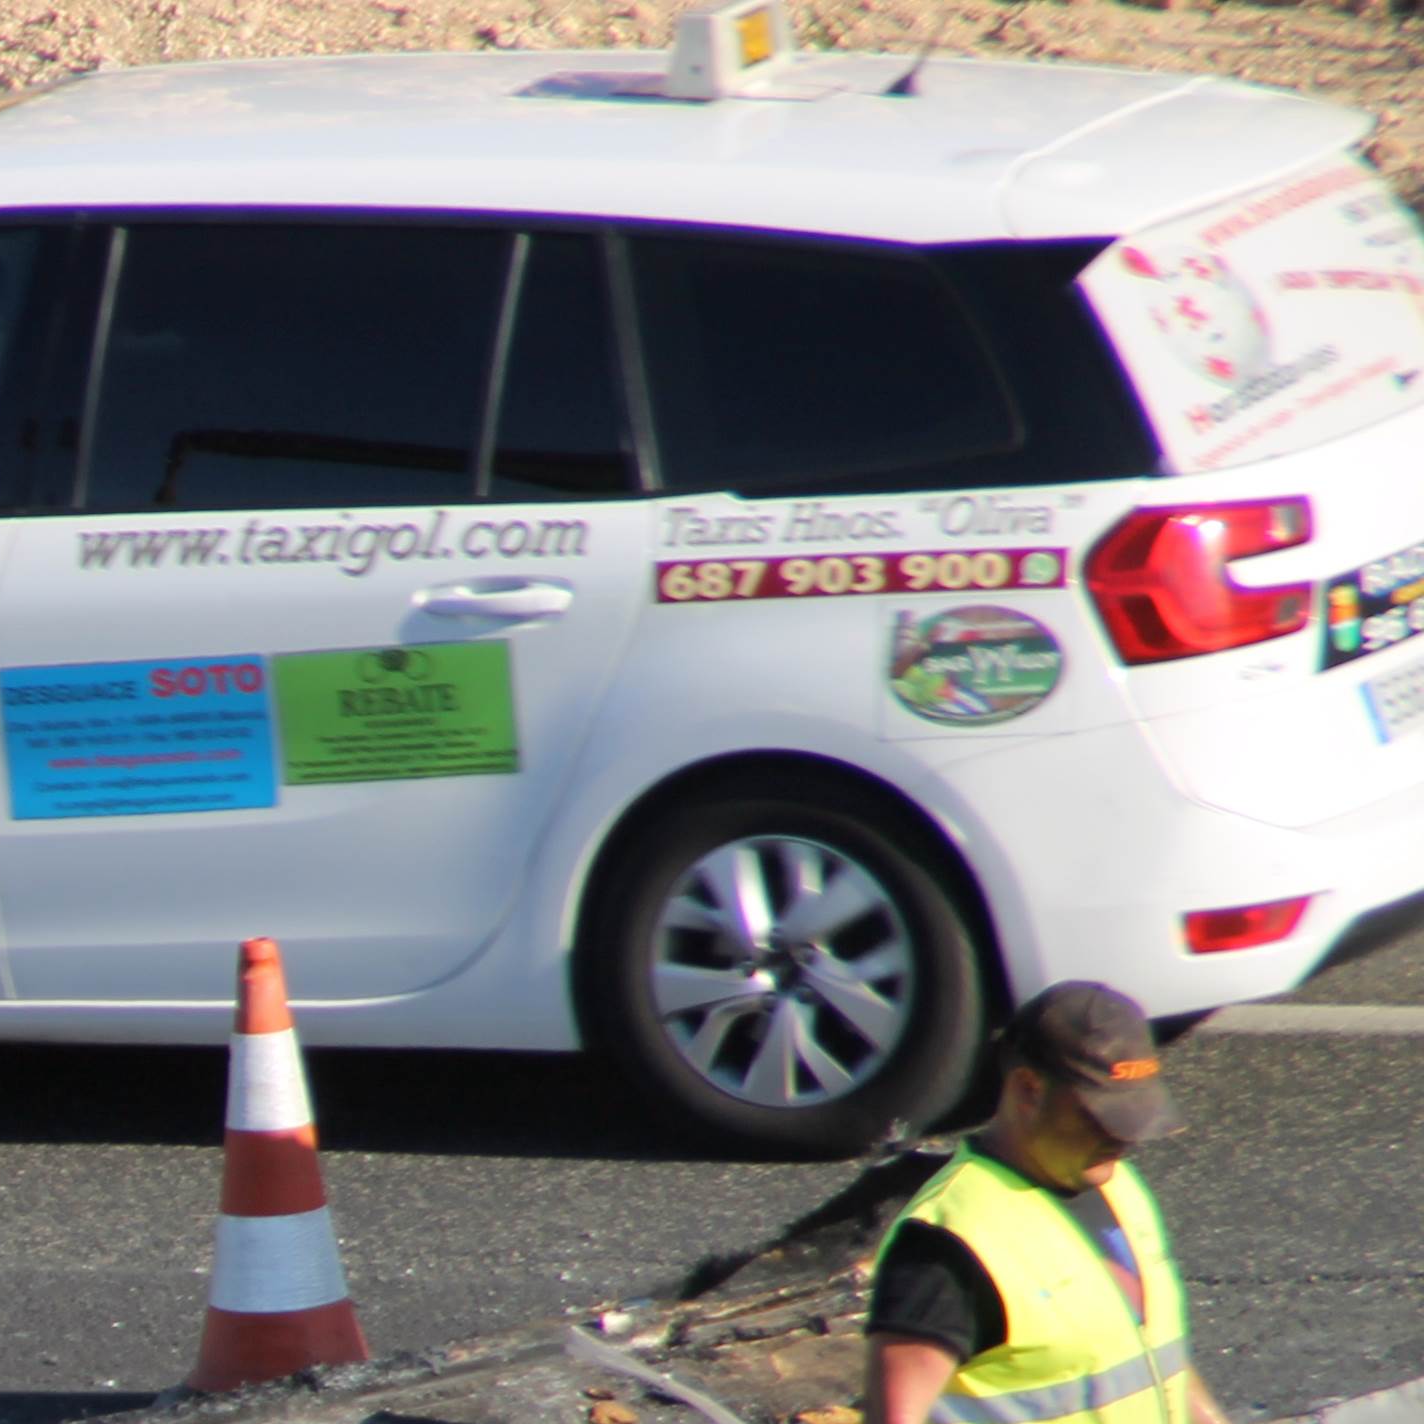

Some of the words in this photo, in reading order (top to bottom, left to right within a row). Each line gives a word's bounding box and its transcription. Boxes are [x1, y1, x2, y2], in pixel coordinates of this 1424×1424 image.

[77, 510, 589, 577] www.taxigol.com
[662, 504, 774, 548] Taxis
[661, 561, 767, 601] 687
[778, 556, 887, 594] 903
[898, 550, 1010, 589] 900
[148, 662, 264, 699] SOTO
